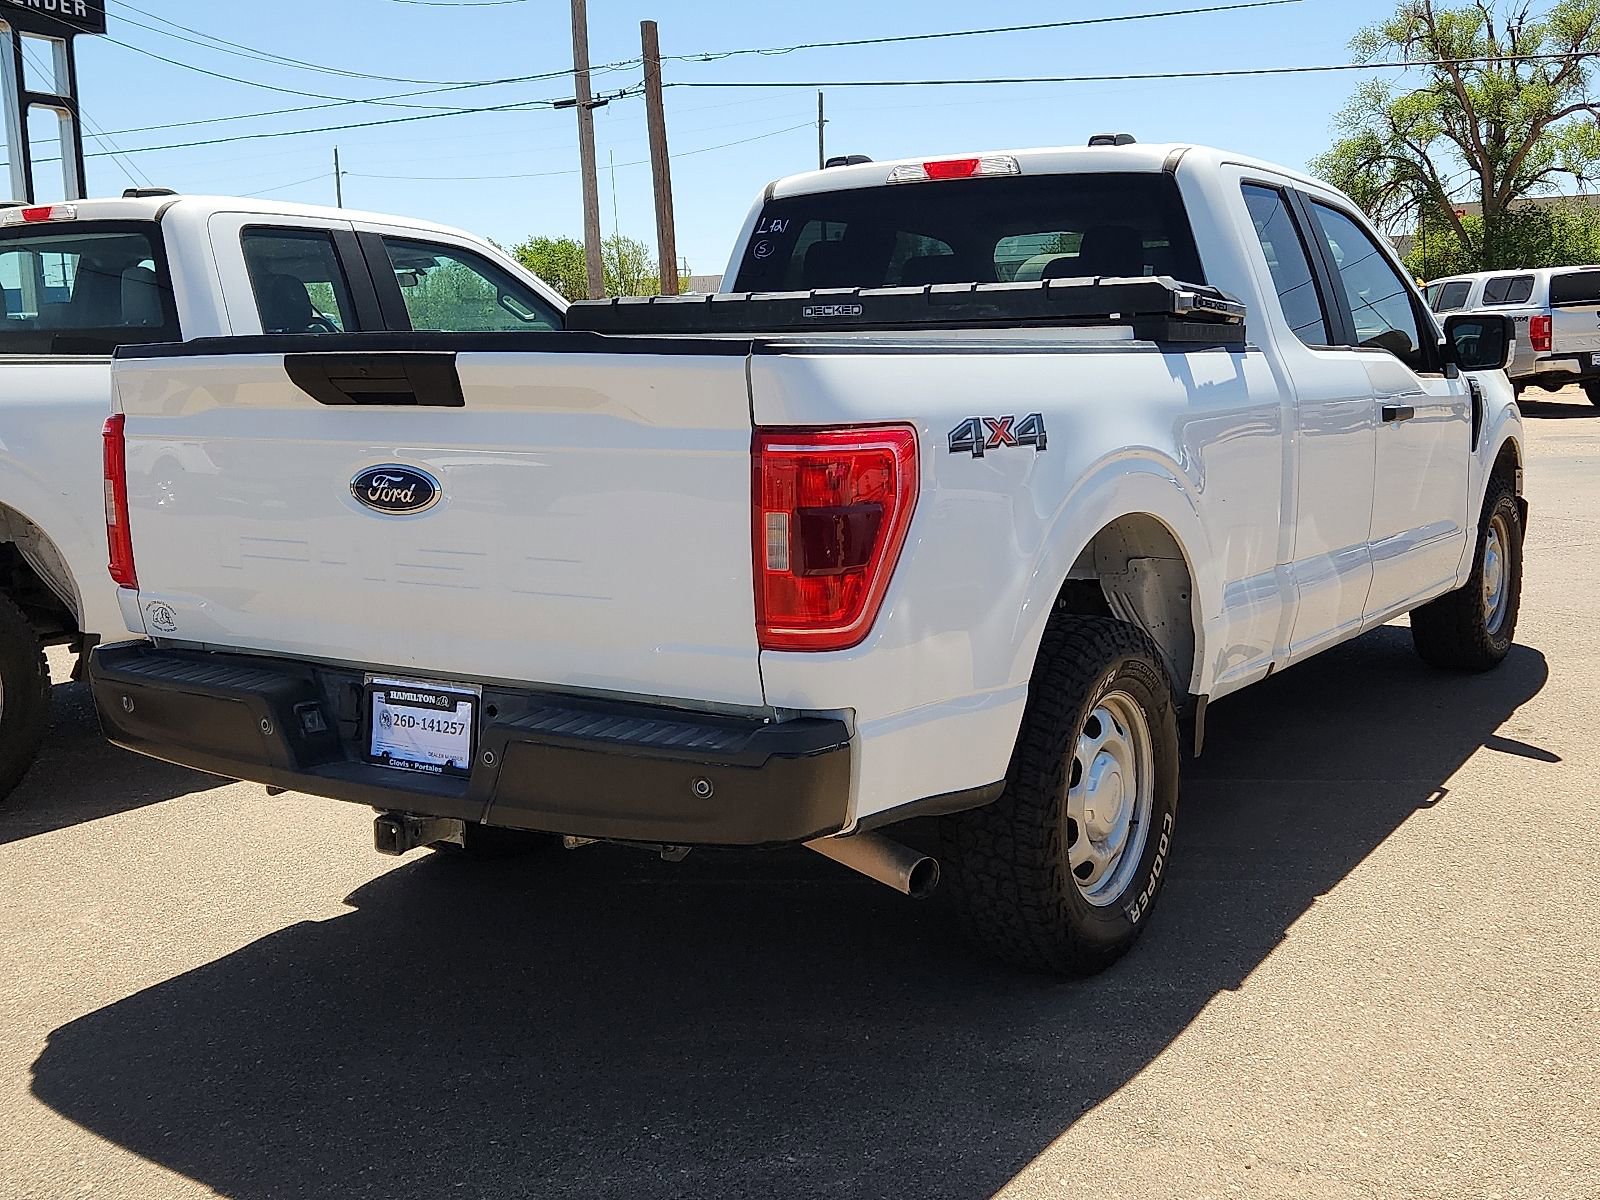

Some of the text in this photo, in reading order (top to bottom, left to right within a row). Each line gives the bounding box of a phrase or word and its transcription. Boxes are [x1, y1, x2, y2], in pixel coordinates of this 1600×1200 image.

[803, 303, 863, 317] DECKED
[367, 474, 417, 503] Ford
[389, 690, 436, 704] HAMILTON
[393, 713, 465, 736] 26D-141257
[1130, 812, 1173, 924] COOPER
